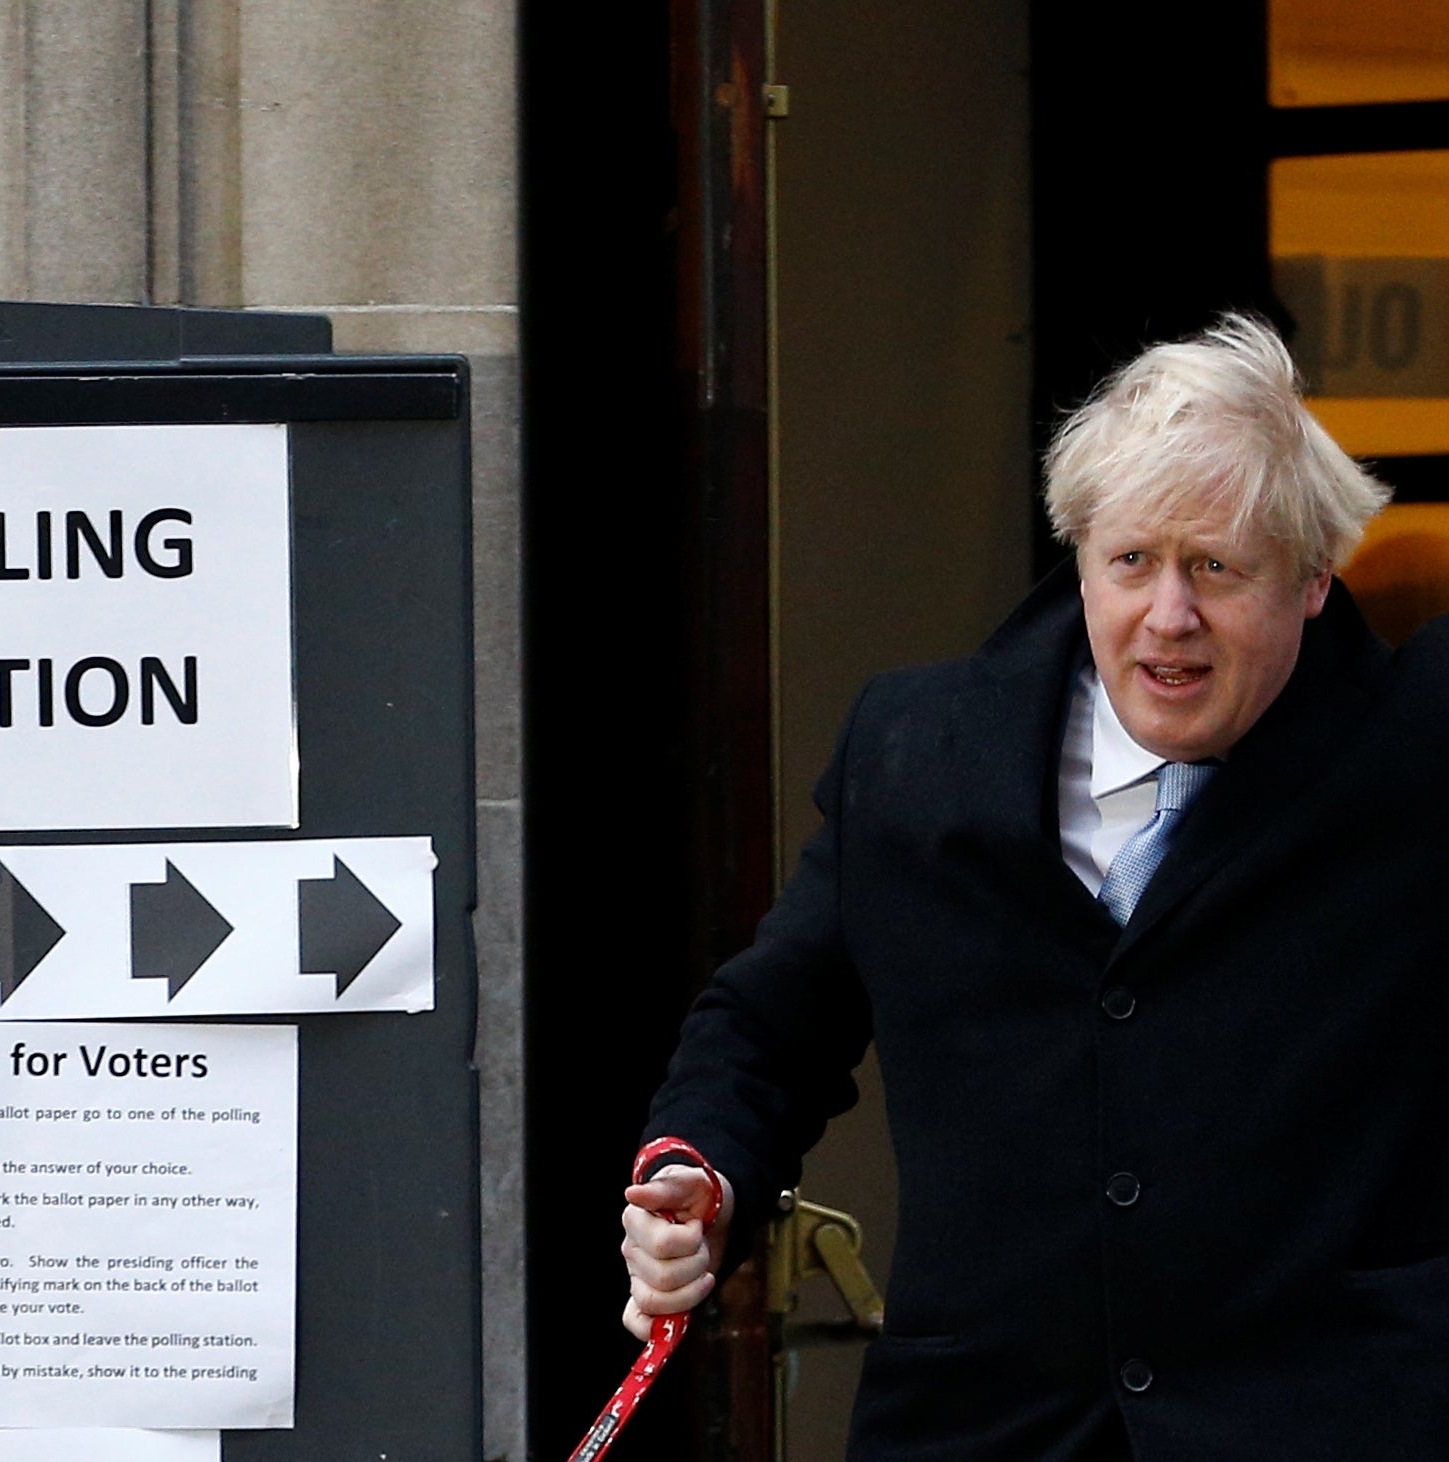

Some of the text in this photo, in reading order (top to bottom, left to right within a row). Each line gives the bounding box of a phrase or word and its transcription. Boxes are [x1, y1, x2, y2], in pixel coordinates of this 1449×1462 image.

[9, 1042, 67, 1077] for
[78, 1045, 208, 1079] Voters
[35, 1109, 78, 1122] paper
[82, 1109, 101, 1123] go
[106, 1108, 122, 1120] to
[127, 1110, 155, 1121] one
[160, 1106, 176, 1121] of
[181, 1107, 205, 1121] the
[211, 1108, 260, 1125] polling
[1, 1160, 26, 1174] the
[30, 1163, 83, 1174] answer
[86, 1160, 102, 1175] of
[104, 1164, 138, 1178] your
[141, 1161, 191, 1176] choice.
[13, 1192, 38, 1206] the
[42, 1192, 84, 1206] ballot
[88, 1195, 130, 1209] paper
[134, 1193, 147, 1207] in
[151, 1196, 178, 1210] any
[181, 1194, 221, 1208] other
[224, 1197, 259, 1211] way,
[28, 1254, 68, 1268] Show
[75, 1254, 100, 1269] the
[107, 1255, 173, 1272] presiding
[180, 1255, 227, 1270] officer
[234, 1256, 258, 1270] the
[42, 1277, 79, 1291] mark
[83, 1281, 102, 1292] on
[105, 1277, 130, 1292] the
[133, 1278, 166, 1292] back
[170, 1278, 186, 1292] of
[188, 1278, 213, 1292] the
[216, 1279, 258, 1293] ballot
[11, 1303, 44, 1317] your
[47, 1302, 84, 1314] vote.
[23, 1332, 49, 1346] box
[52, 1332, 80, 1346] and
[82, 1332, 121, 1346] leave
[123, 1332, 148, 1347] the
[150, 1332, 200, 1350] polling
[202, 1333, 257, 1347] station.
[1, 1363, 20, 1380] by
[22, 1364, 83, 1380] mistake,
[86, 1364, 126, 1378] show
[129, 1364, 140, 1378] it
[143, 1366, 159, 1378] to
[162, 1365, 187, 1379] the
[191, 1365, 257, 1382] presiding
